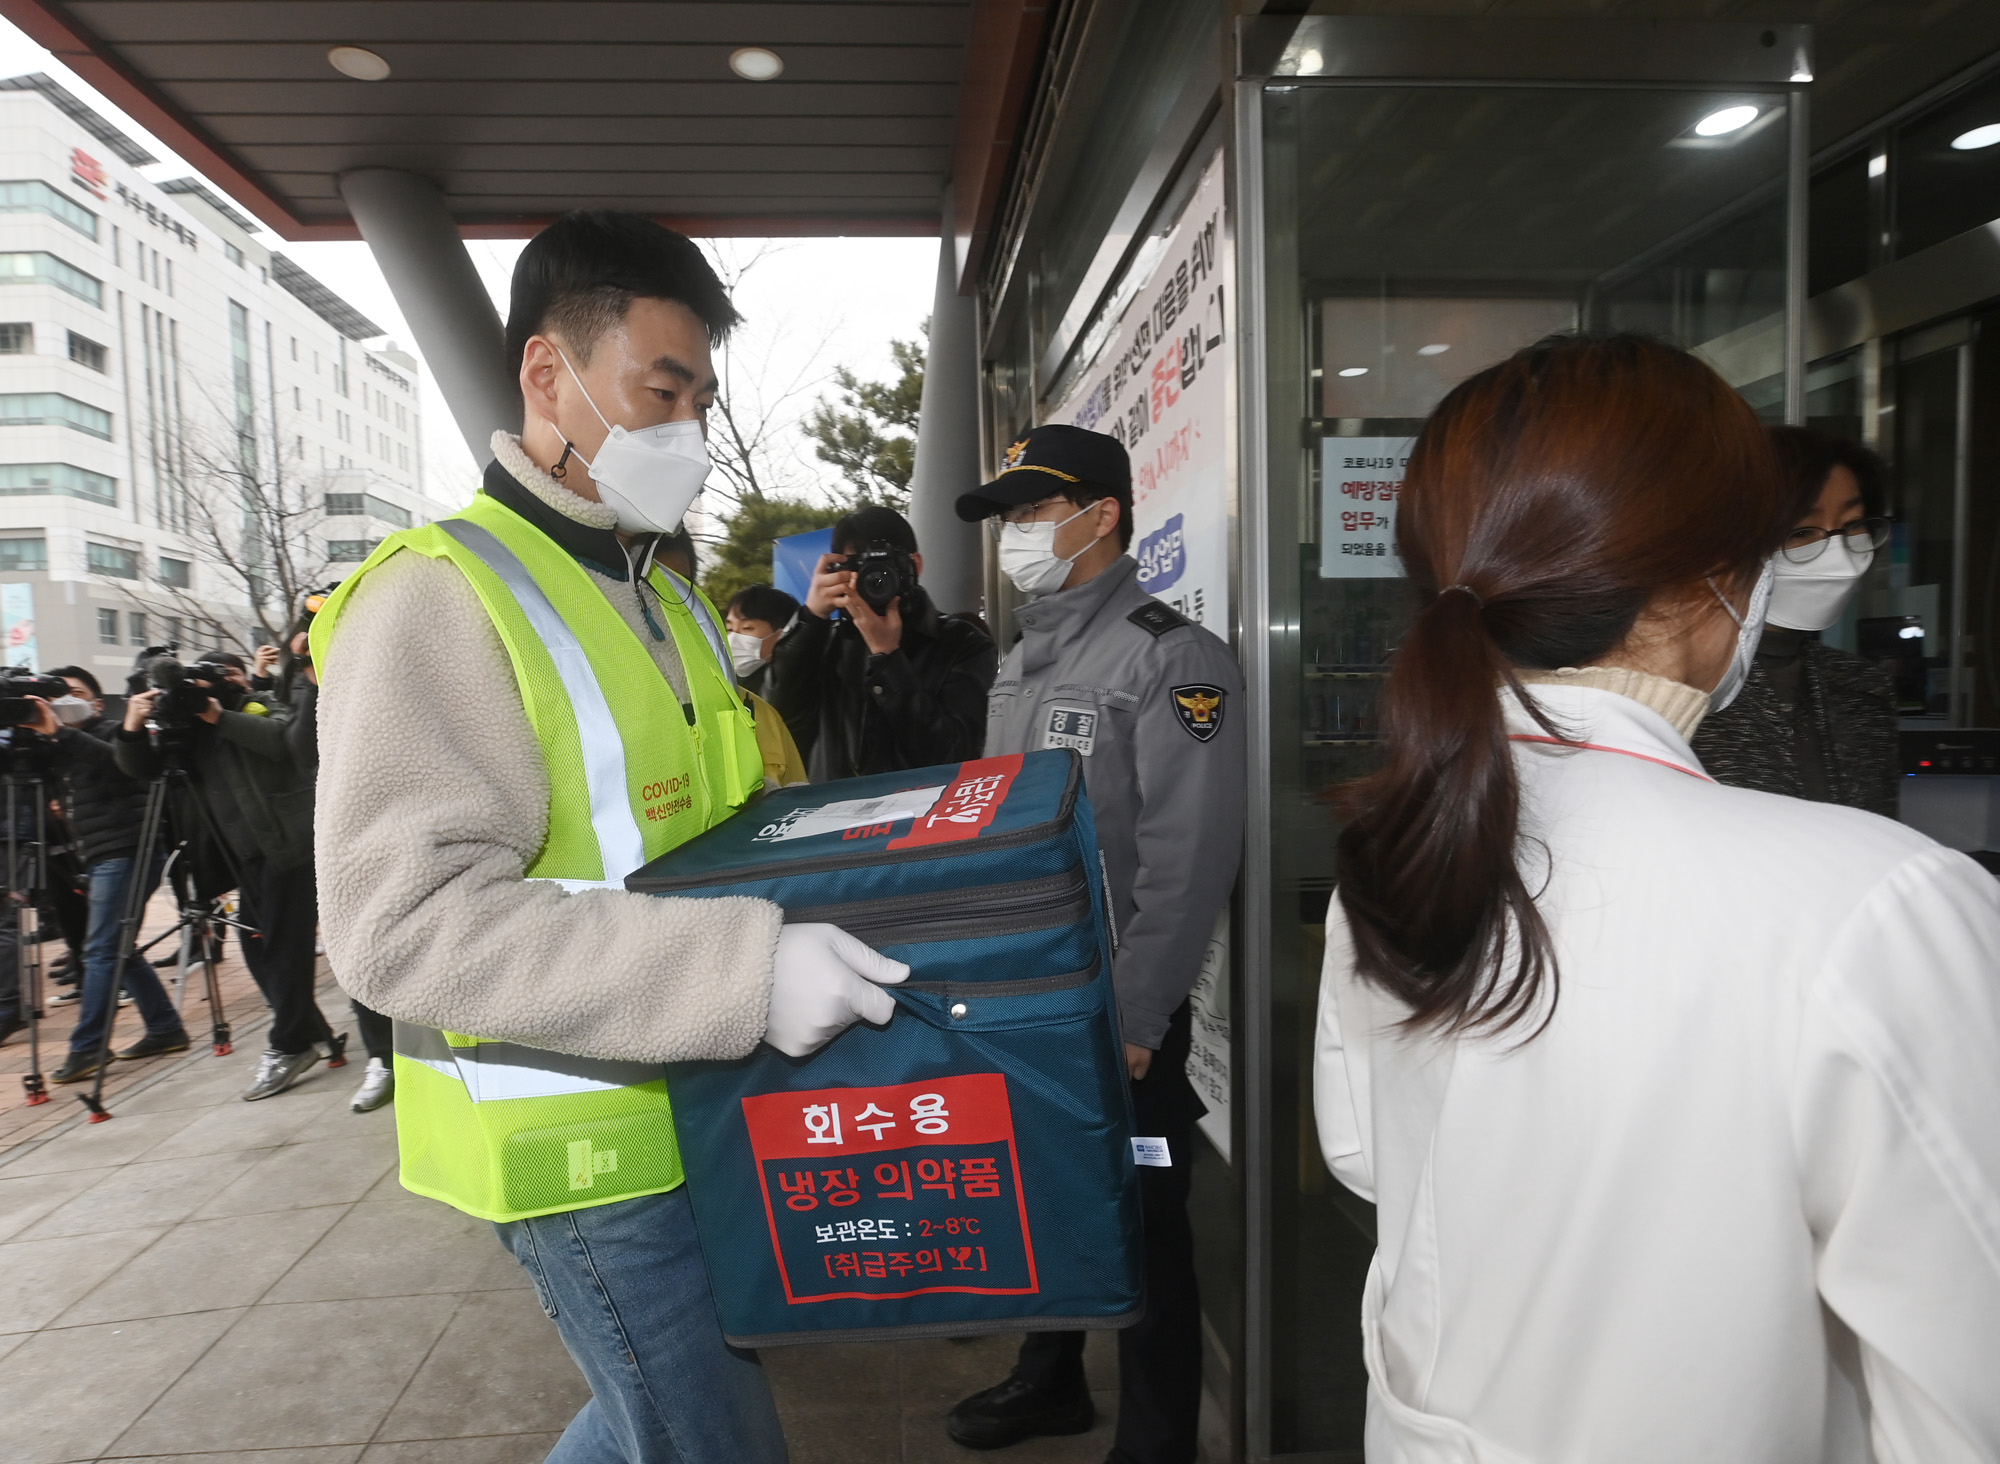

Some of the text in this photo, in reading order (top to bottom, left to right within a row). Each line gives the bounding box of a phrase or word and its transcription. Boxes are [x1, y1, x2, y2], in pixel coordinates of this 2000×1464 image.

[1342, 457, 1394, 469] 코로나19
[1341, 511, 1389, 532] 업무가
[1341, 542, 1387, 557] 되었음을
[1053, 712, 1093, 736] 경찰
[1049, 735, 1090, 751] POLICE
[643, 772, 690, 801] COVID-19
[802, 1093, 949, 1145] 회수용
[778, 1157, 1000, 1211] 냉장 의약품
[815, 1218, 899, 1243] 보관온도
